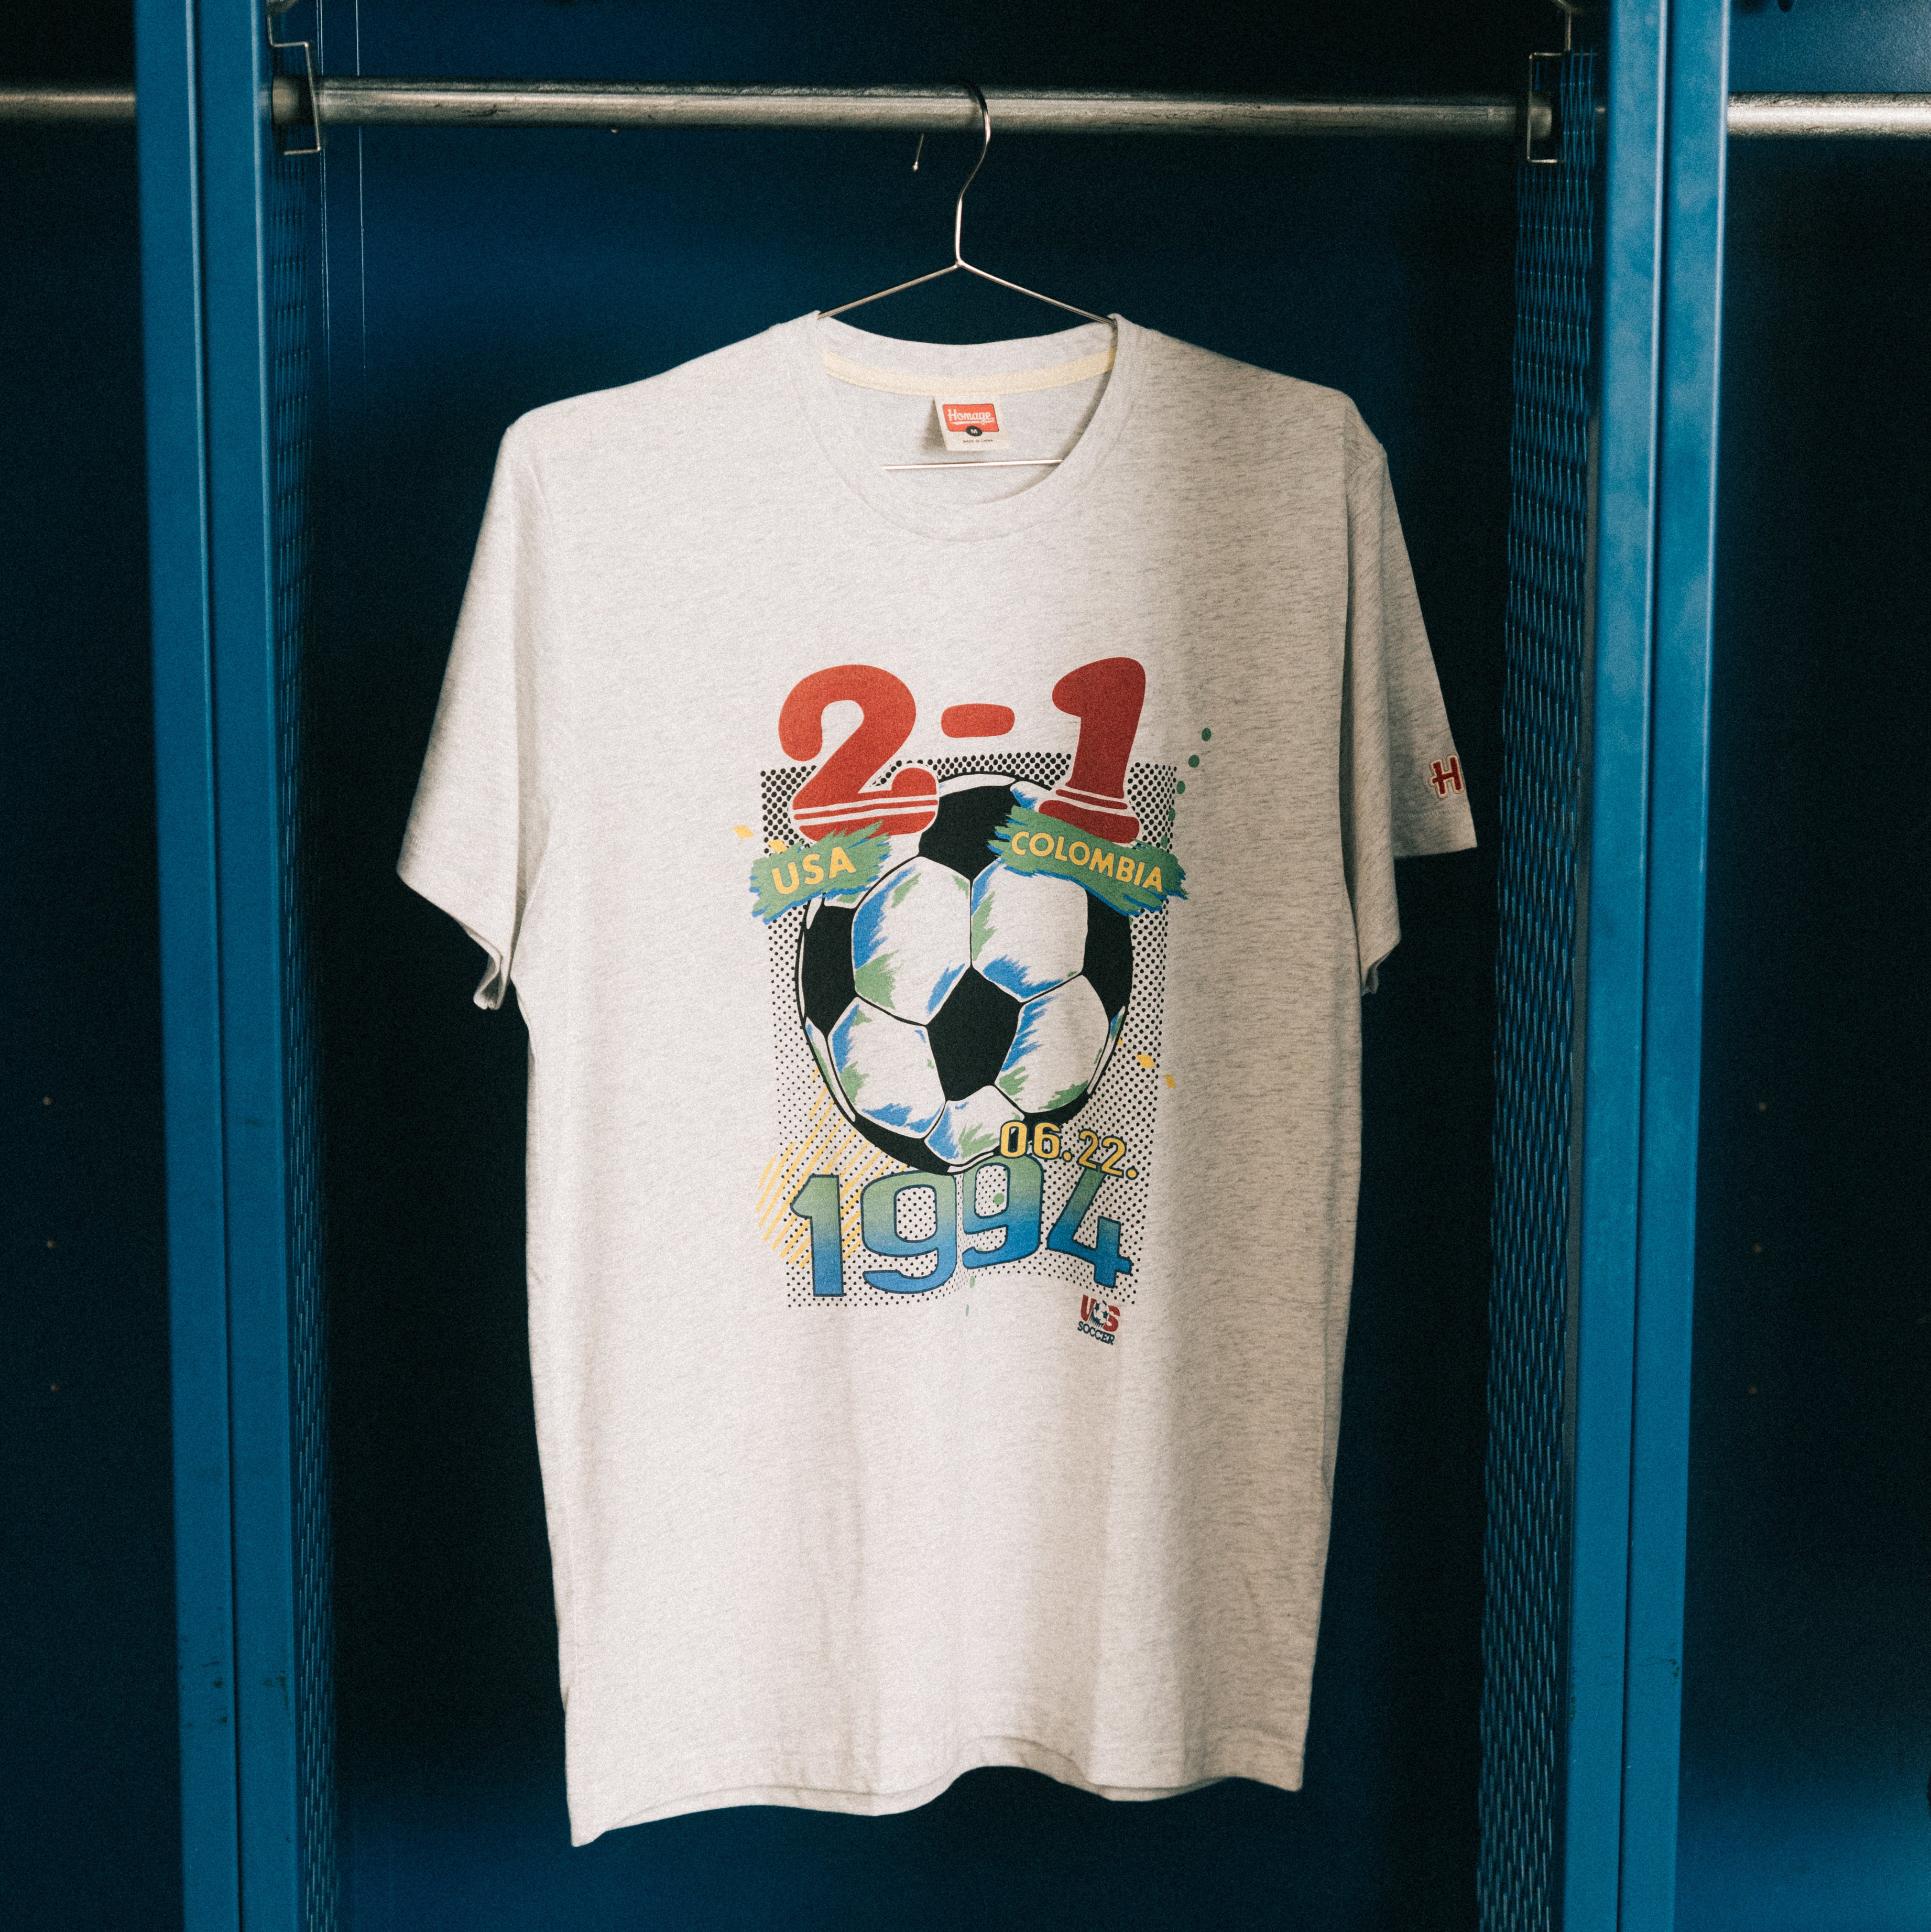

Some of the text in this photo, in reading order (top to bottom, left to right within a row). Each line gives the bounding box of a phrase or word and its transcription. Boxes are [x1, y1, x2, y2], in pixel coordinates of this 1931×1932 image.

[947, 409, 994, 425] Homage
[771, 847, 856, 895] USA
[1011, 831, 1163, 893] COLOMBIA
[1000, 1120, 1139, 1180] 06.22.
[790, 1153, 1133, 1297] 1994
[1077, 1320, 1115, 1345] SOCCER
